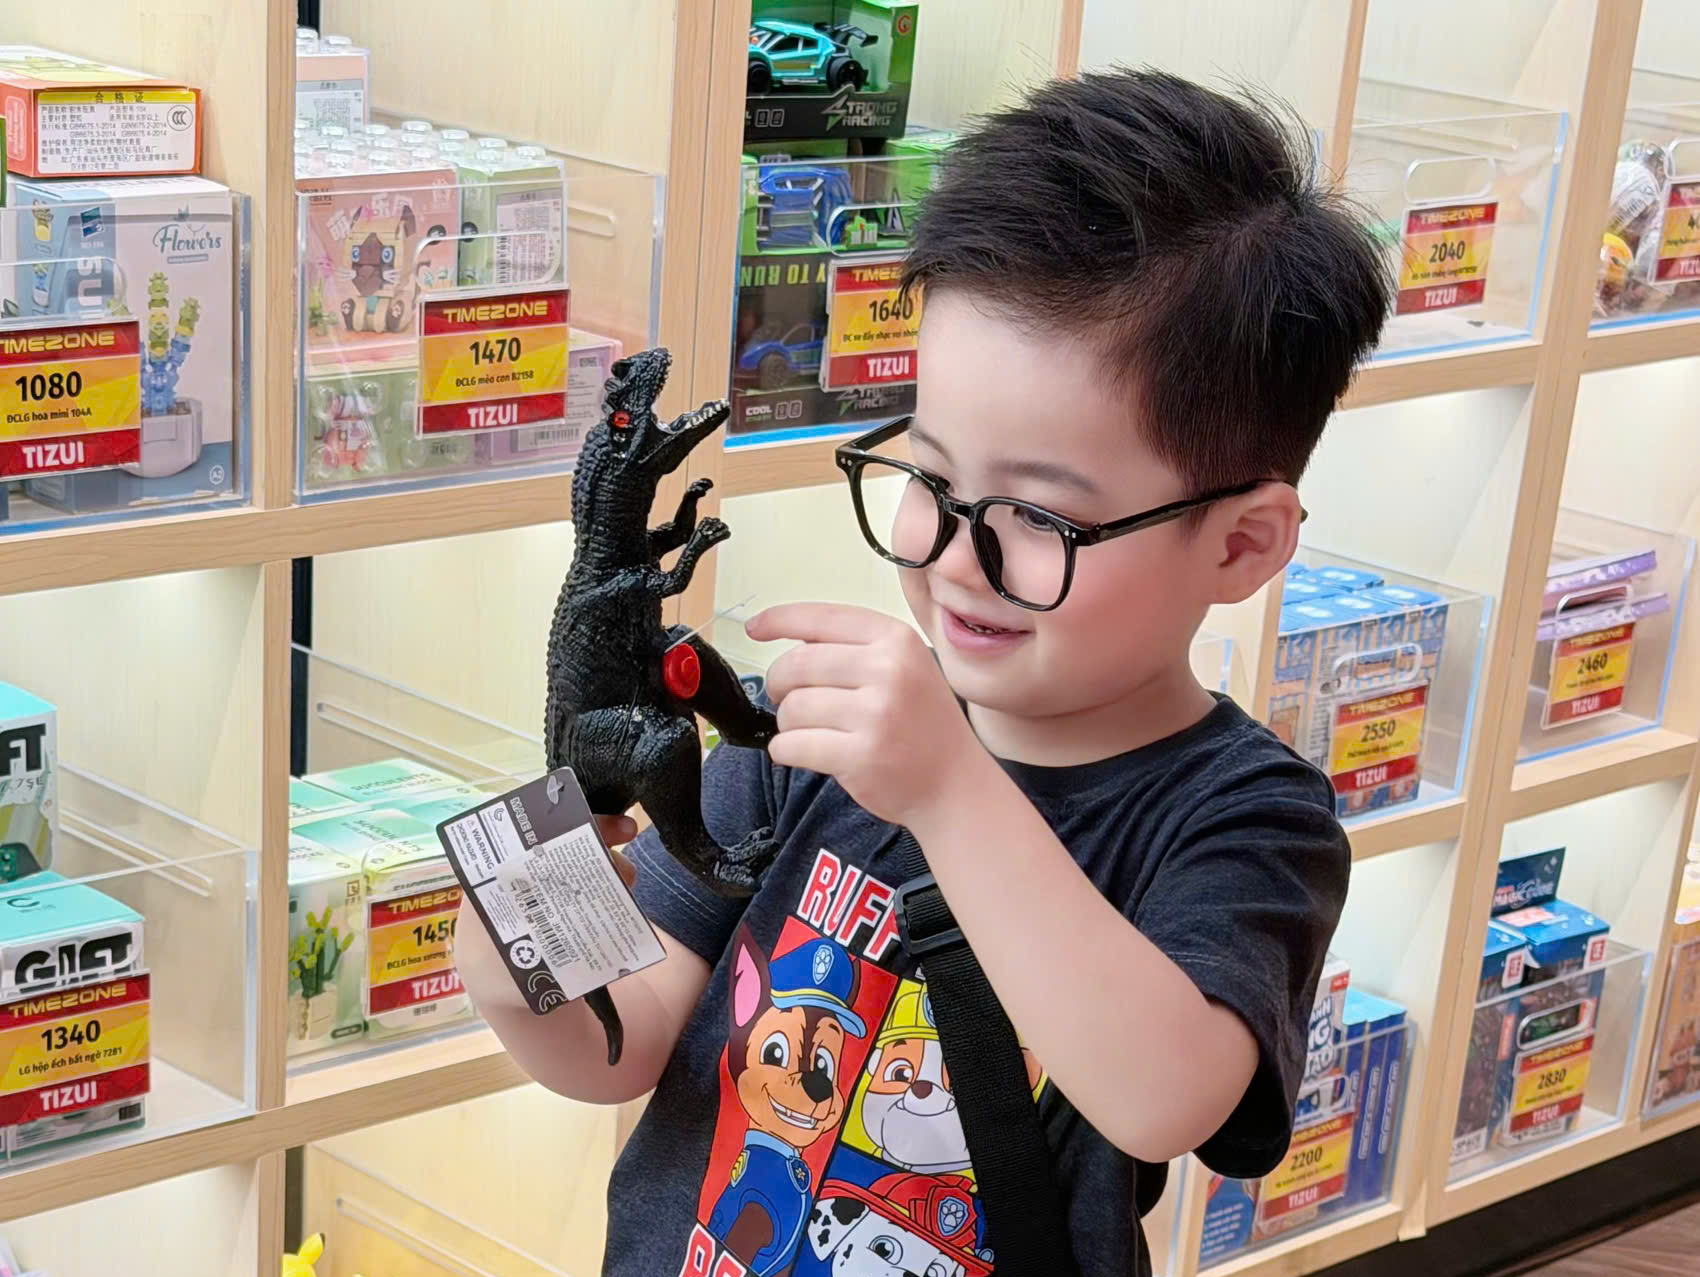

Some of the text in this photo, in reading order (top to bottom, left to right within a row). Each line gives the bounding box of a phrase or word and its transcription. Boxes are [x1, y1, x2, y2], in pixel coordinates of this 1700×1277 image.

[1429, 240, 1466, 264] 2040
[1424, 287, 1458, 308] TIZUI
[443, 300, 549, 324] TIMEZONE
[869, 298, 914, 323] 1640
[469, 337, 522, 366] 1470
[867, 355, 910, 378] TIZUI
[15, 371, 83, 402] 1080
[32, 411, 48, 421] hoa
[50, 409, 69, 420] mini
[467, 404, 518, 428] TIZUI
[22, 441, 85, 469] TIZUI
[1577, 652, 1608, 675] 2460
[1572, 694, 1600, 716] TIZUI
[1361, 719, 1396, 743] 2550
[1355, 765, 1388, 788] TIZUI
[507, 796, 539, 846] MADE IN
[468, 828, 498, 871] WARNING
[9, 983, 128, 1019] TIMEZONE
[41, 1020, 101, 1053] 1340
[19, 1064, 31, 1076] LG
[1538, 1068, 1567, 1090] 2830
[40, 1081, 97, 1111] TIZUI
[1290, 1146, 1323, 1171] 2200
[1289, 1185, 1319, 1209] TIZUI
